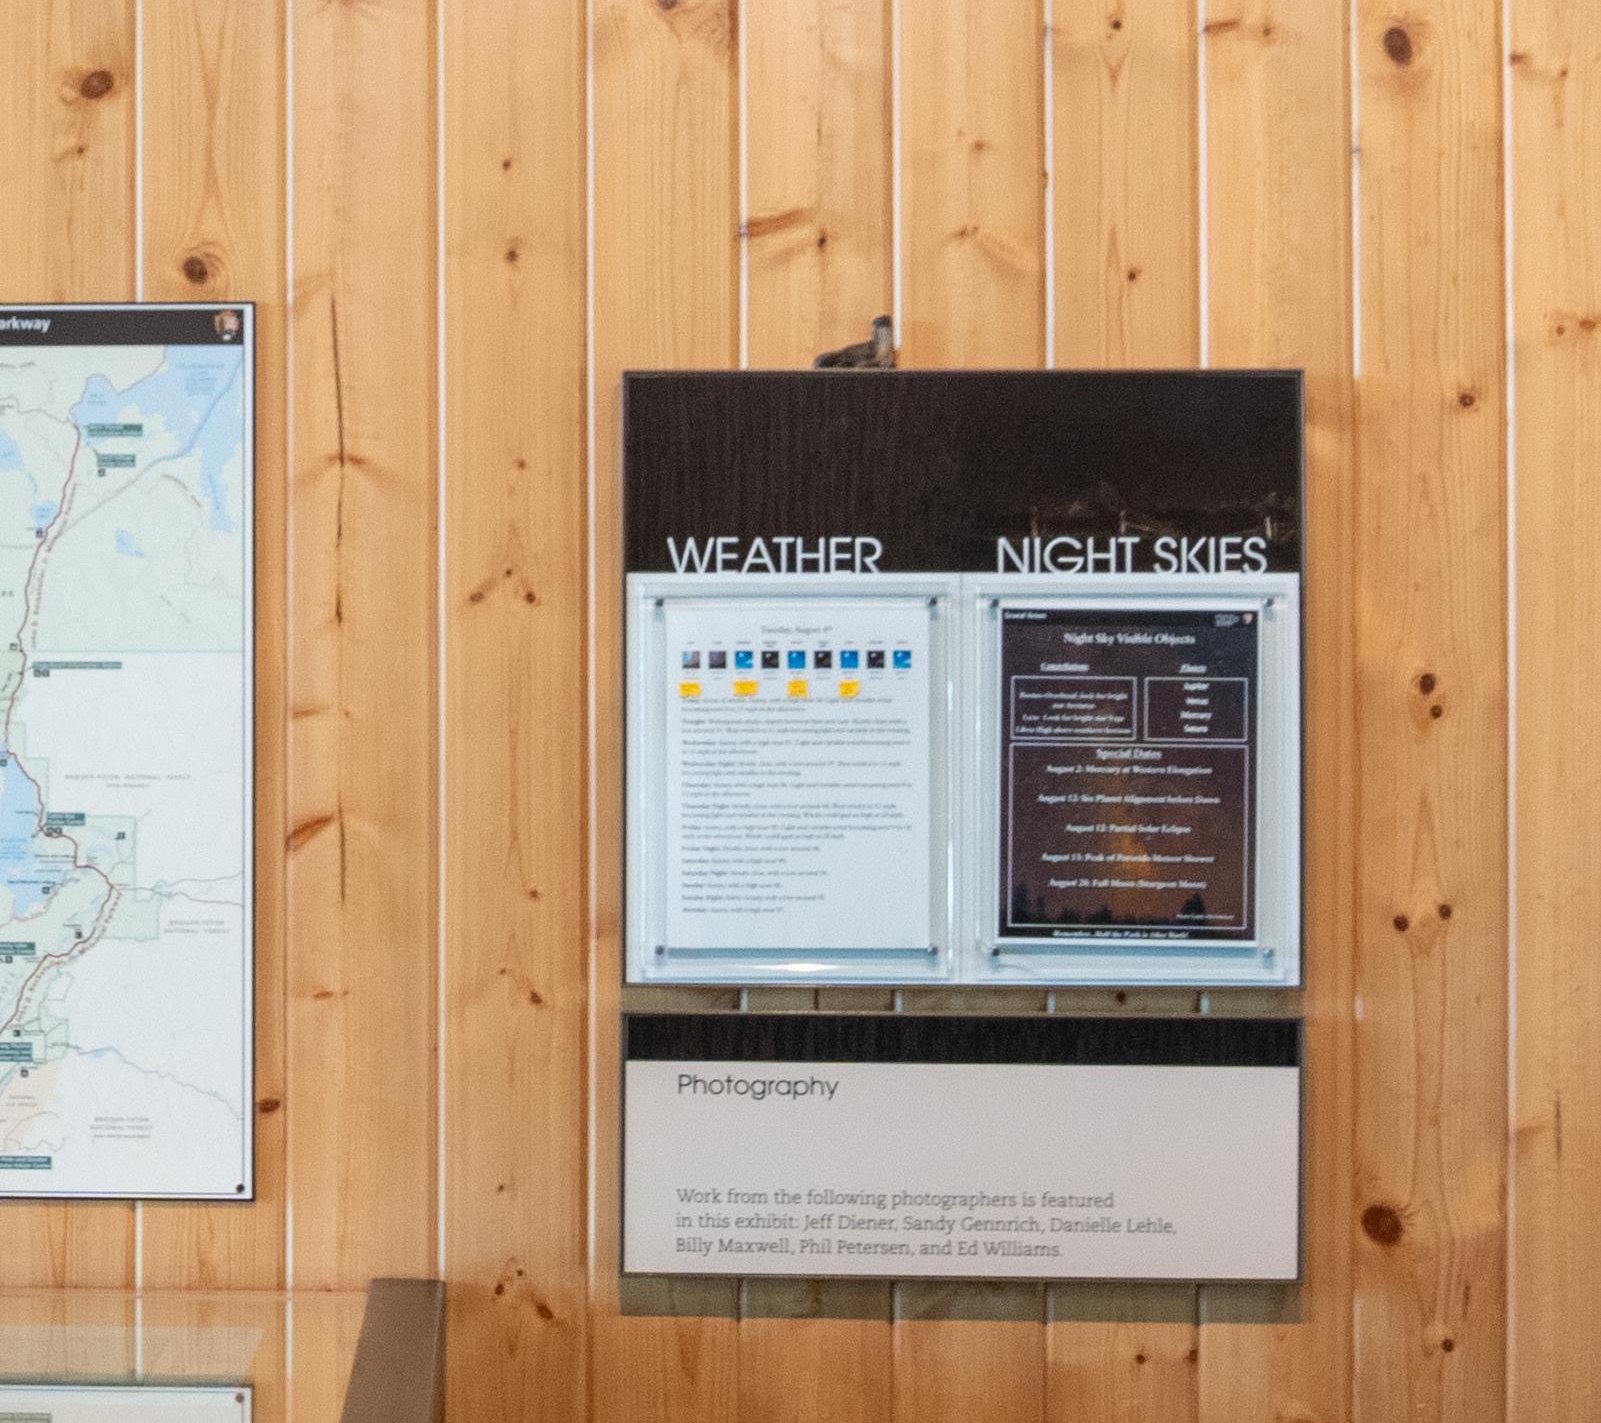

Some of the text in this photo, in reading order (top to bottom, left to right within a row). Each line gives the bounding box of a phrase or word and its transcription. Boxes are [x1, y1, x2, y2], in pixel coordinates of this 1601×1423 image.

[666, 535, 884, 575] WEATHER
[997, 535, 1269, 575] NIGHT SKIES
[676, 1074, 840, 1101] Photography
[676, 1188, 1114, 1211] Work from the following photographers is featured
[676, 1212, 692, 1228] in
[697, 1212, 730, 1228] this
[803, 1213, 834, 1231] Jeff
[837, 1214, 898, 1232] Diener,
[902, 1215, 956, 1235] Sandy
[1050, 1217, 1121, 1233] Danielle
[676, 1237, 713, 1256] Billy
[717, 1237, 795, 1256] Maxwell,
[800, 1238, 833, 1255] Phil
[837, 1239, 915, 1256] Petersen,
[920, 1240, 952, 1256] and
[957, 1241, 978, 1256] Ed
